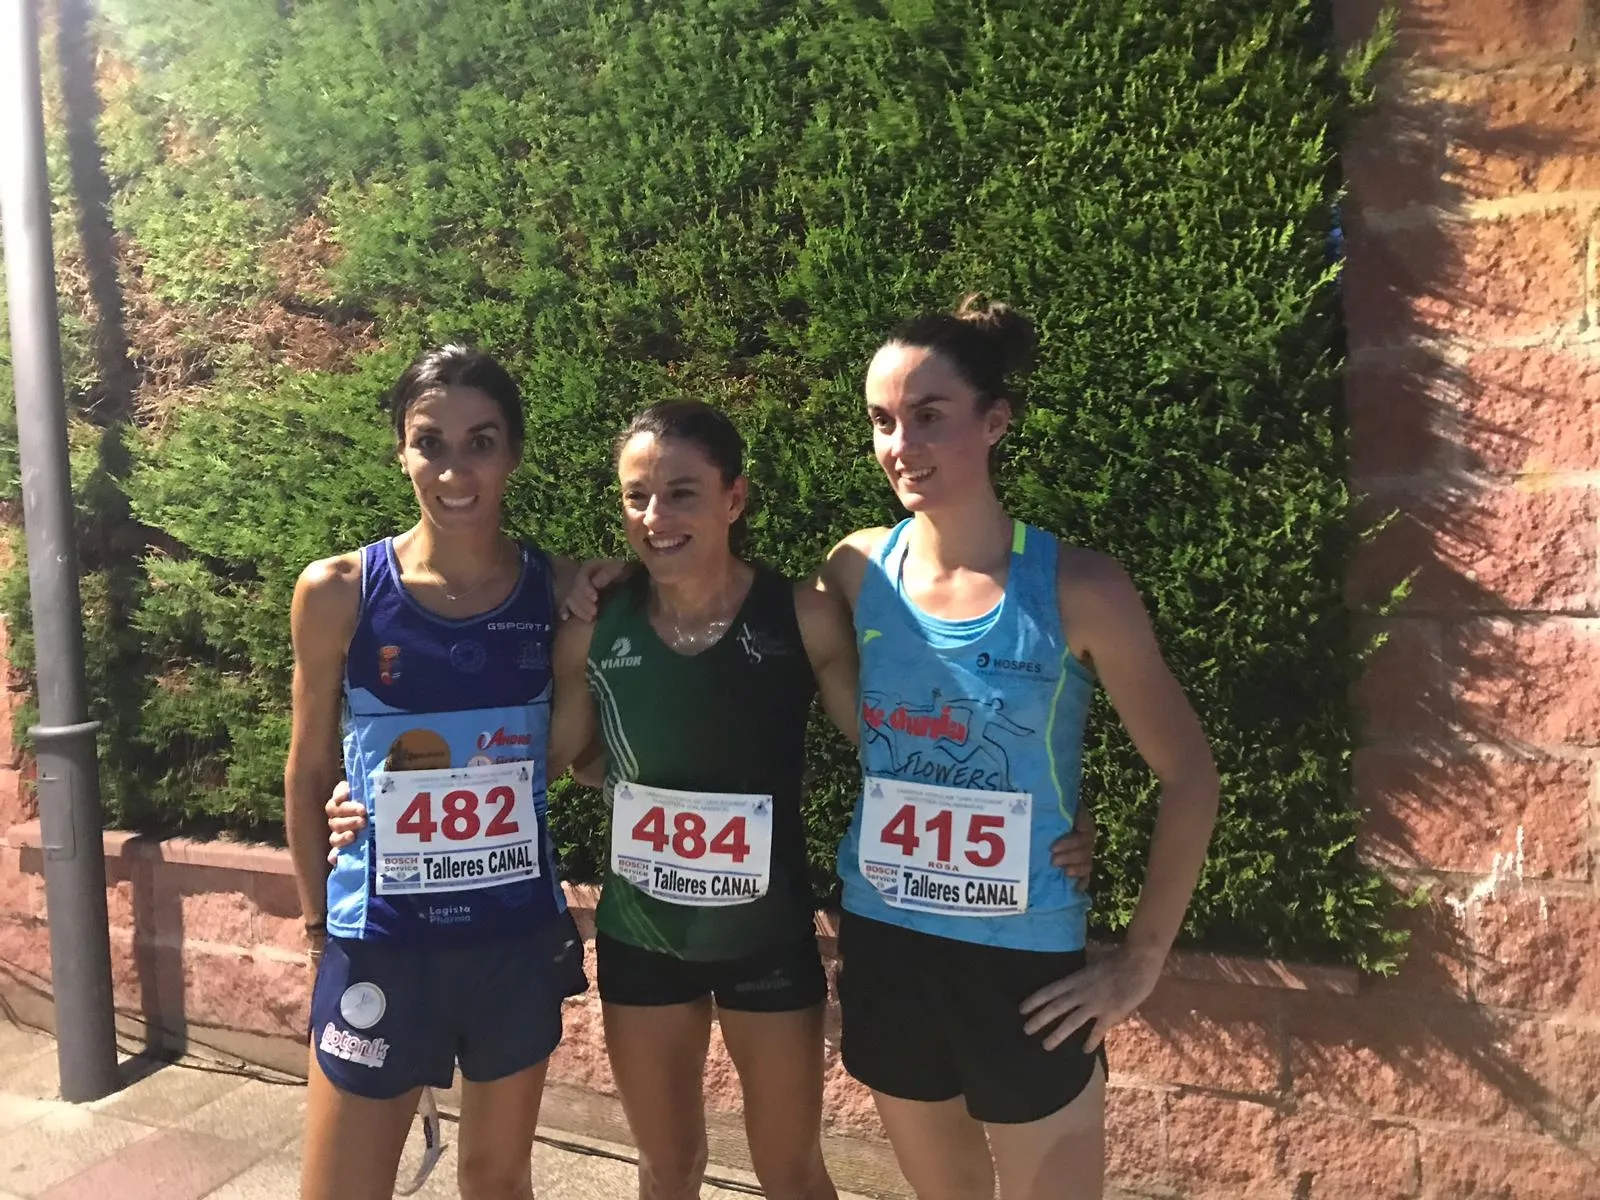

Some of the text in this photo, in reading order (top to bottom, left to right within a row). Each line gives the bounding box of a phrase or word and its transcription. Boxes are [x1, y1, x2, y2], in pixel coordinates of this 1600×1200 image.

[600, 656, 642, 669] VIATOR
[993, 658, 1042, 673] HOSPES
[903, 751, 999, 791] FLOWERS
[396, 786, 519, 843] 482
[631, 806, 750, 864] 484
[880, 804, 1006, 868] 415
[384, 857, 418, 865] BOSCH
[423, 845, 533, 880] Talleres CANAL
[618, 859, 649, 871] BOSCH
[866, 865, 898, 876] BOSCH
[928, 861, 960, 872] ROSA
[654, 866, 760, 898] Talleres CANAL
[866, 872, 897, 883] Service
[903, 871, 1018, 906] Talleres CANAL
